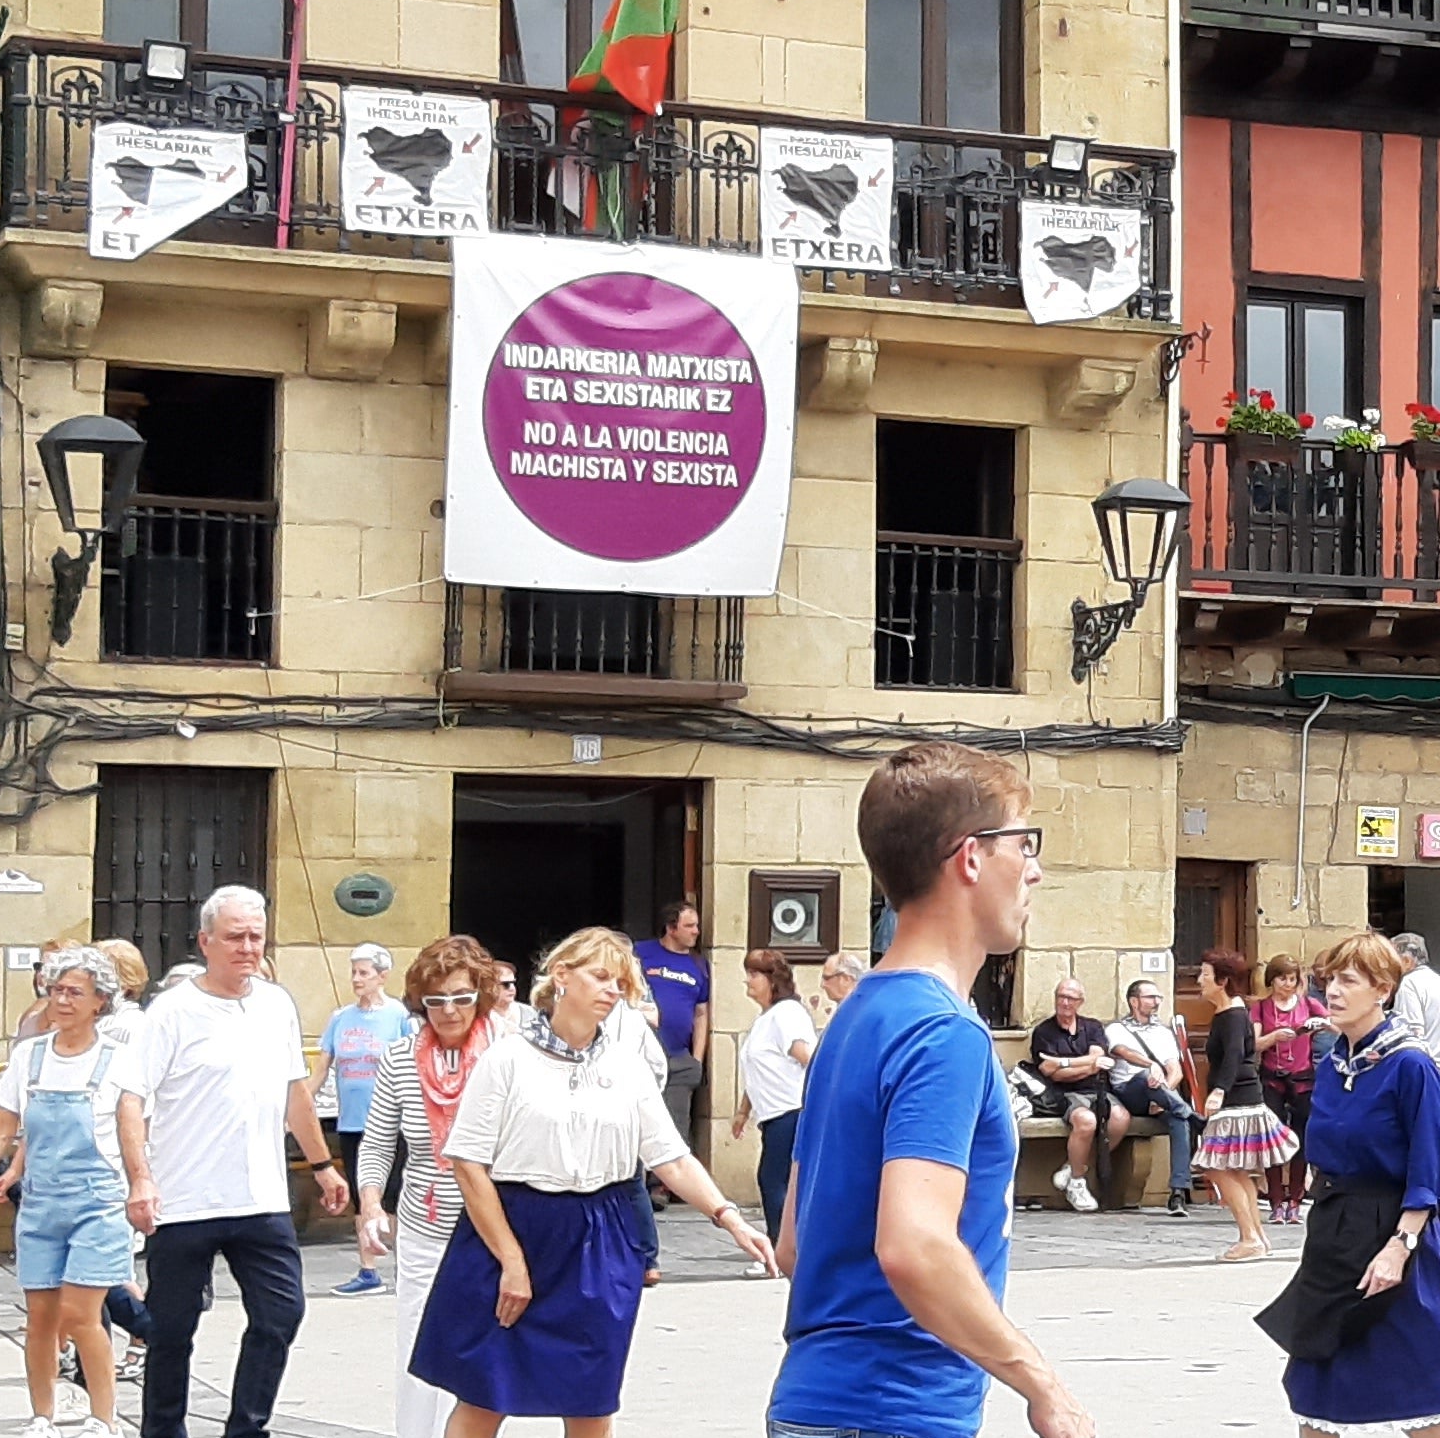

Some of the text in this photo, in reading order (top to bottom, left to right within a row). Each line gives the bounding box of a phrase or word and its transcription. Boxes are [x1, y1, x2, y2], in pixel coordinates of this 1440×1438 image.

[424, 101, 447, 111] ETA
[116, 135, 212, 157] IHESLARIAK
[355, 205, 479, 231] ETXERA
[771, 238, 883, 264] ETXERA
[504, 344, 753, 383] INDARKERIA MATXISTA
[525, 376, 733, 413] ETA SEXISTARIK EZ
[524, 421, 729, 456] NO A LA VIOLENCIA
[510, 451, 738, 488] MACHISTA Y SEXISTA
